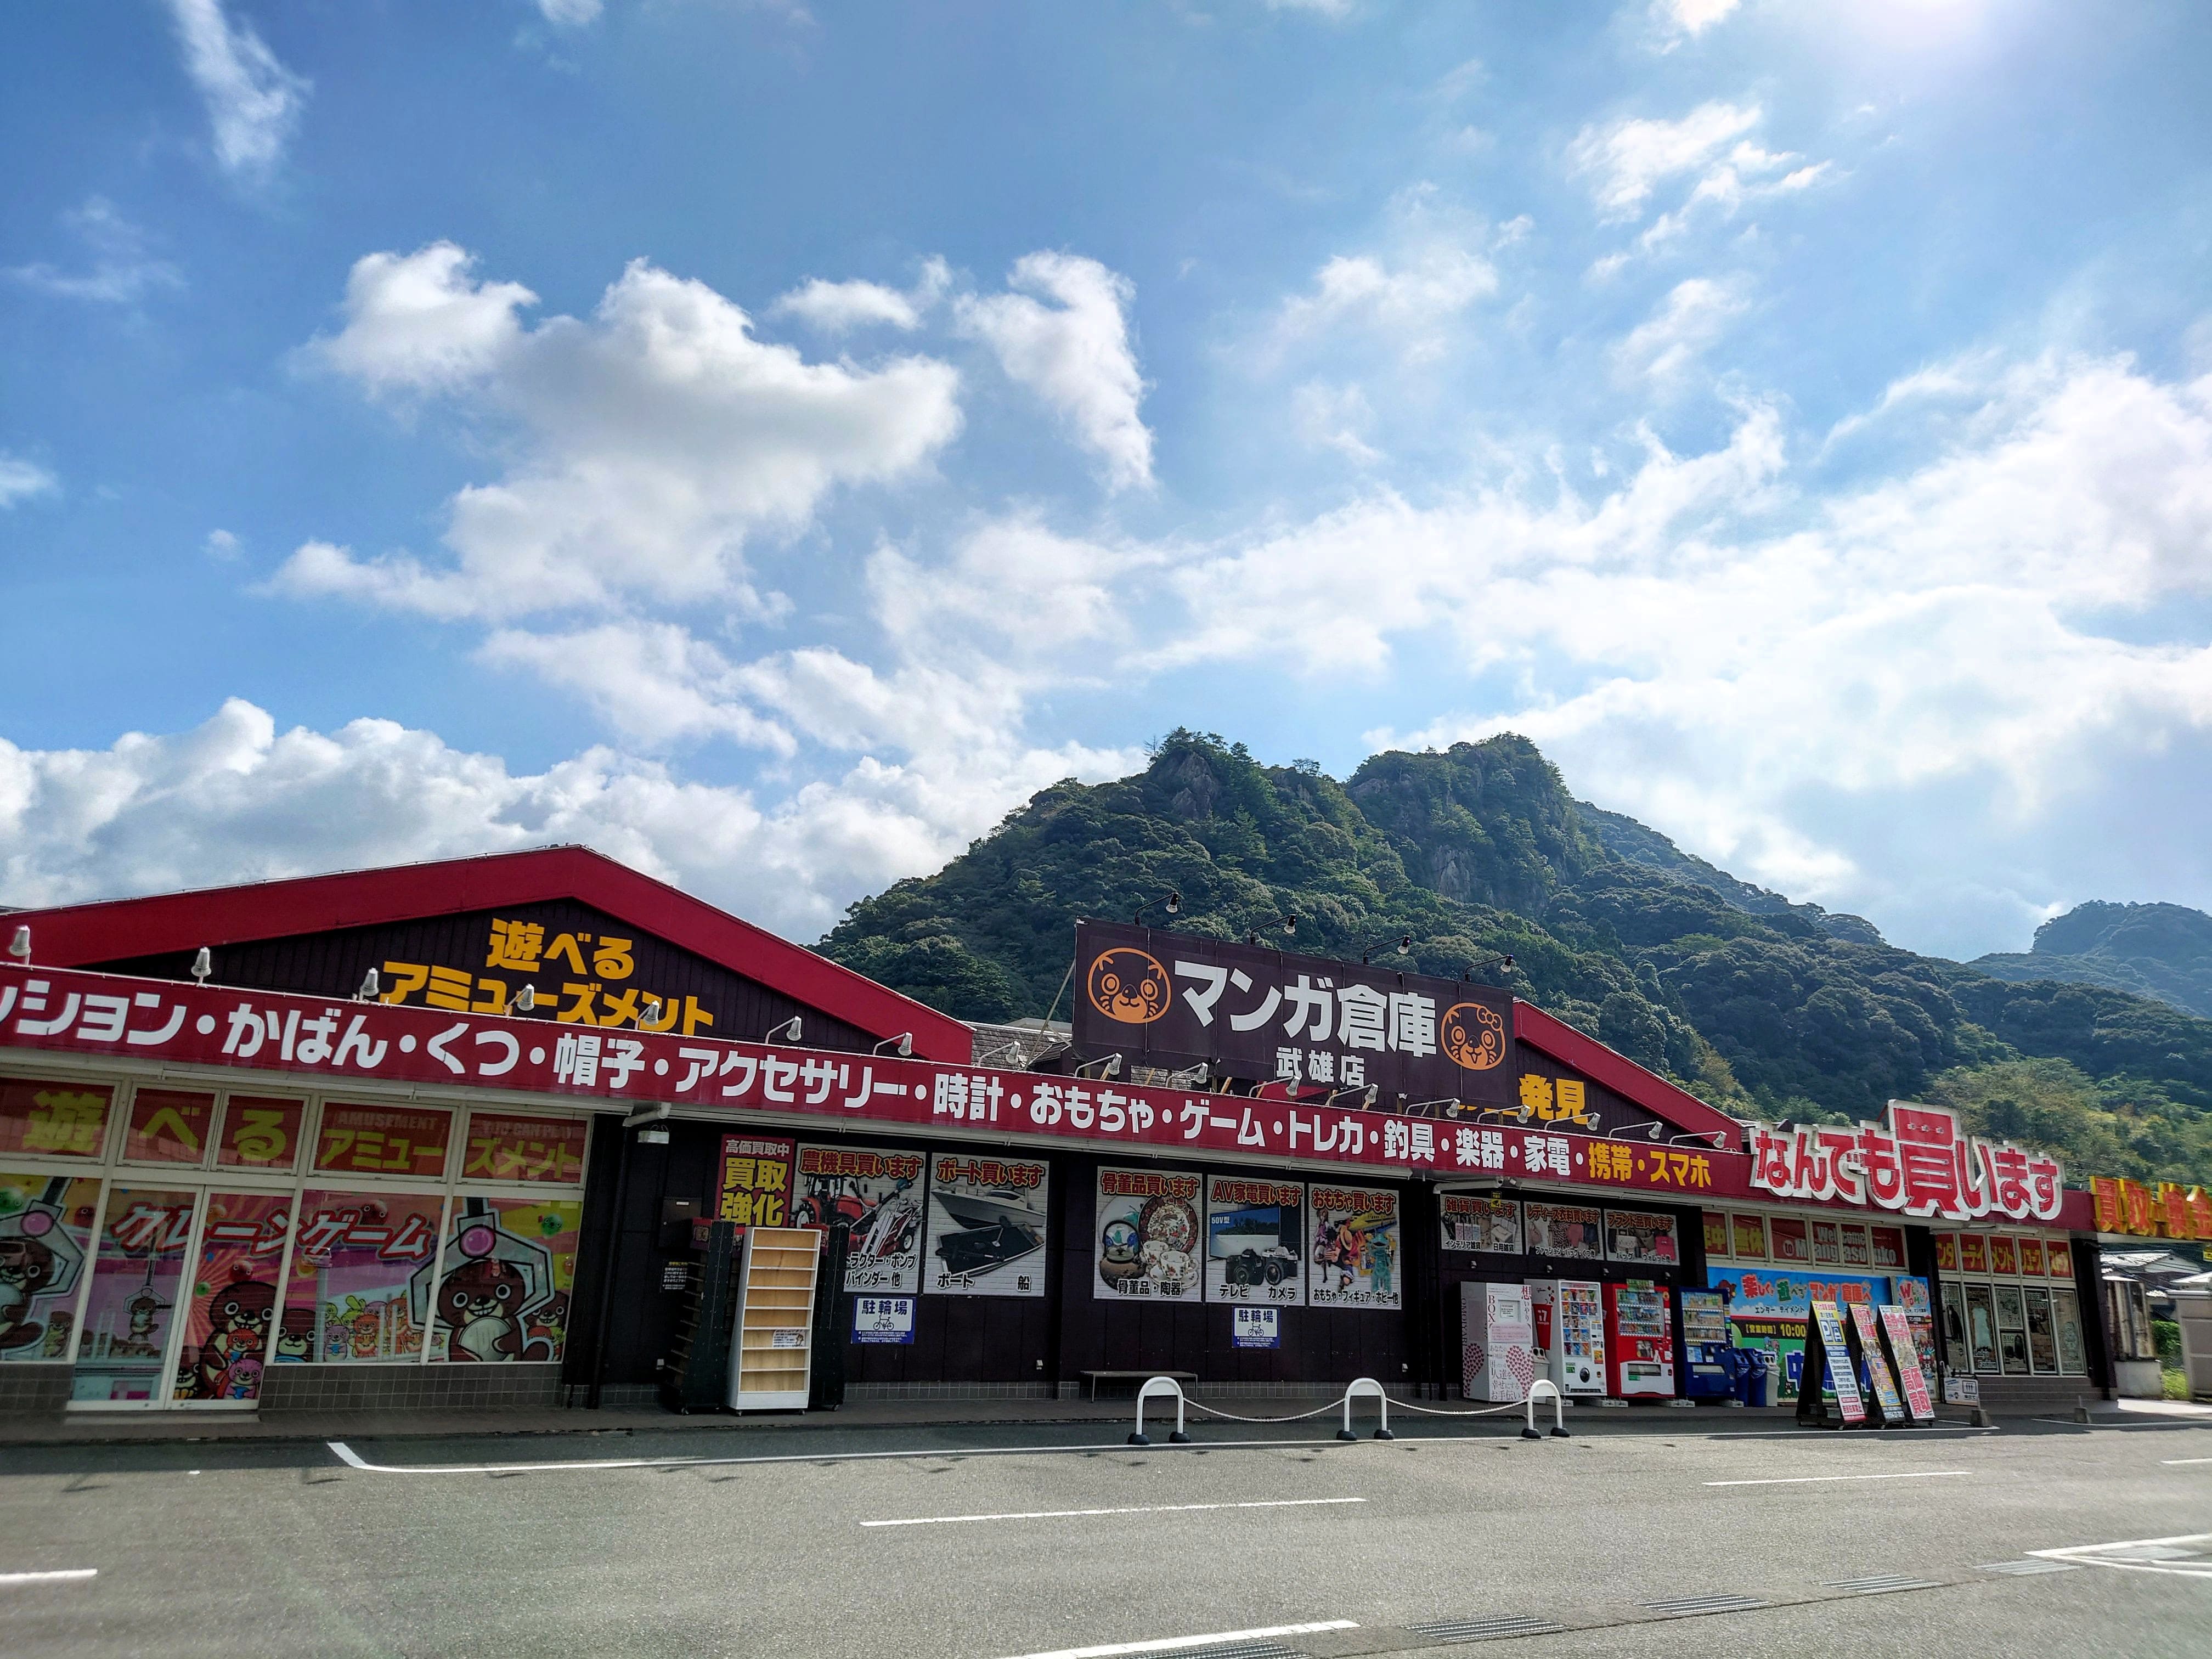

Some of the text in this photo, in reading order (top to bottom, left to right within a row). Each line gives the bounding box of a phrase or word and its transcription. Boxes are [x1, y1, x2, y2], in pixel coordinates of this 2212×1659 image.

[486, 917, 635, 980] 遊べる
[379, 961, 714, 1036] アミューズメント
[1174, 960, 1437, 1058] マンガ倉庫
[1276, 1046, 1365, 1087] 武雄店
[726, 1139, 790, 1156] 高価買取中
[1752, 1104, 2061, 1216] なんでも買います
[723, 1157, 788, 1193] 買取
[800, 1149, 924, 1180] 農機具買います
[937, 1159, 1045, 1187] ボート買います
[1102, 1171, 1199, 1199] 骨董品買います
[1211, 1181, 1302, 1206] AV家電買います
[720, 1192, 785, 1227] 強化
[1312, 1188, 1396, 1214] おもちゃ買います
[114, 1204, 428, 1257] クレーンゲーム
[1211, 1216, 1231, 1224] 50V型
[937, 1273, 1031, 1291] ボート 船
[1219, 1284, 1297, 1300] テレビ カメラ
[862, 1300, 907, 1316] 駐輪場
[1238, 1310, 1273, 1323] 駐輪場
